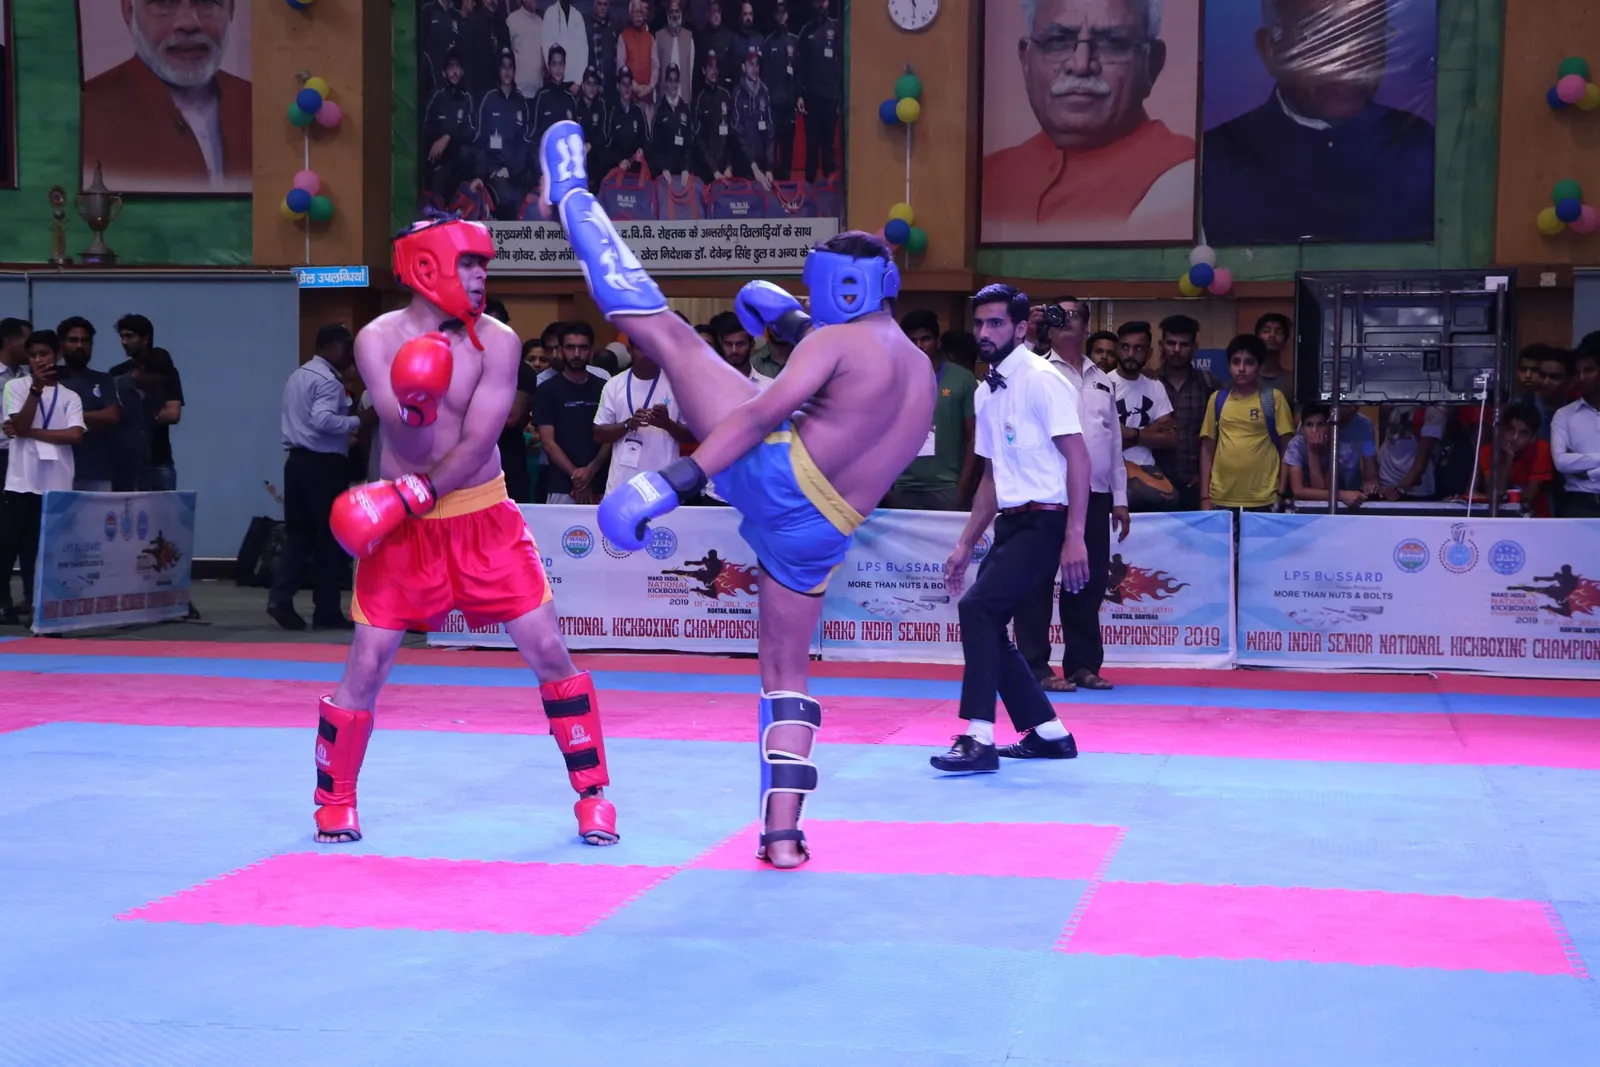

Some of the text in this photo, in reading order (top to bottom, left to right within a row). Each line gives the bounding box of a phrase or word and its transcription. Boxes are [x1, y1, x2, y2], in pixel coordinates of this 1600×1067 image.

[496, 226, 532, 244] मुख्यमंत्री
[534, 226, 545, 240] श्री
[547, 228, 568, 240] मनो
[657, 226, 686, 240] रोहतक
[782, 224, 792, 237] के
[794, 226, 812, 237] साथ
[492, 246, 510, 260] नीष
[539, 248, 557, 261] खेल
[559, 248, 575, 260] मंत्री
[640, 247, 658, 260] खेल
[660, 246, 692, 260] निदेशक
[709, 246, 732, 260] देवेन्द्र
[734, 245, 751, 259] सिंह
[770, 248, 776, 258] व
[778, 248, 797, 258] अन्य
[857, 562, 881, 572] LPS
[1284, 570, 1310, 580] LPS
[441, 614, 464, 633] AKO
[558, 616, 608, 636] ATIONAL
[612, 618, 679, 638] KICKBOXING
[684, 619, 760, 639] CHAMPIONSH
[823, 621, 856, 640] WAKO
[861, 621, 893, 640] INDIA
[898, 622, 940, 642] SENIOR
[1100, 625, 1179, 645] AMPIONSHIP
[1184, 626, 1220, 646] 2019
[1246, 631, 1600, 660] WAKO INDIA SENIOR NATIONAL KICKBOXING CHAMPION
